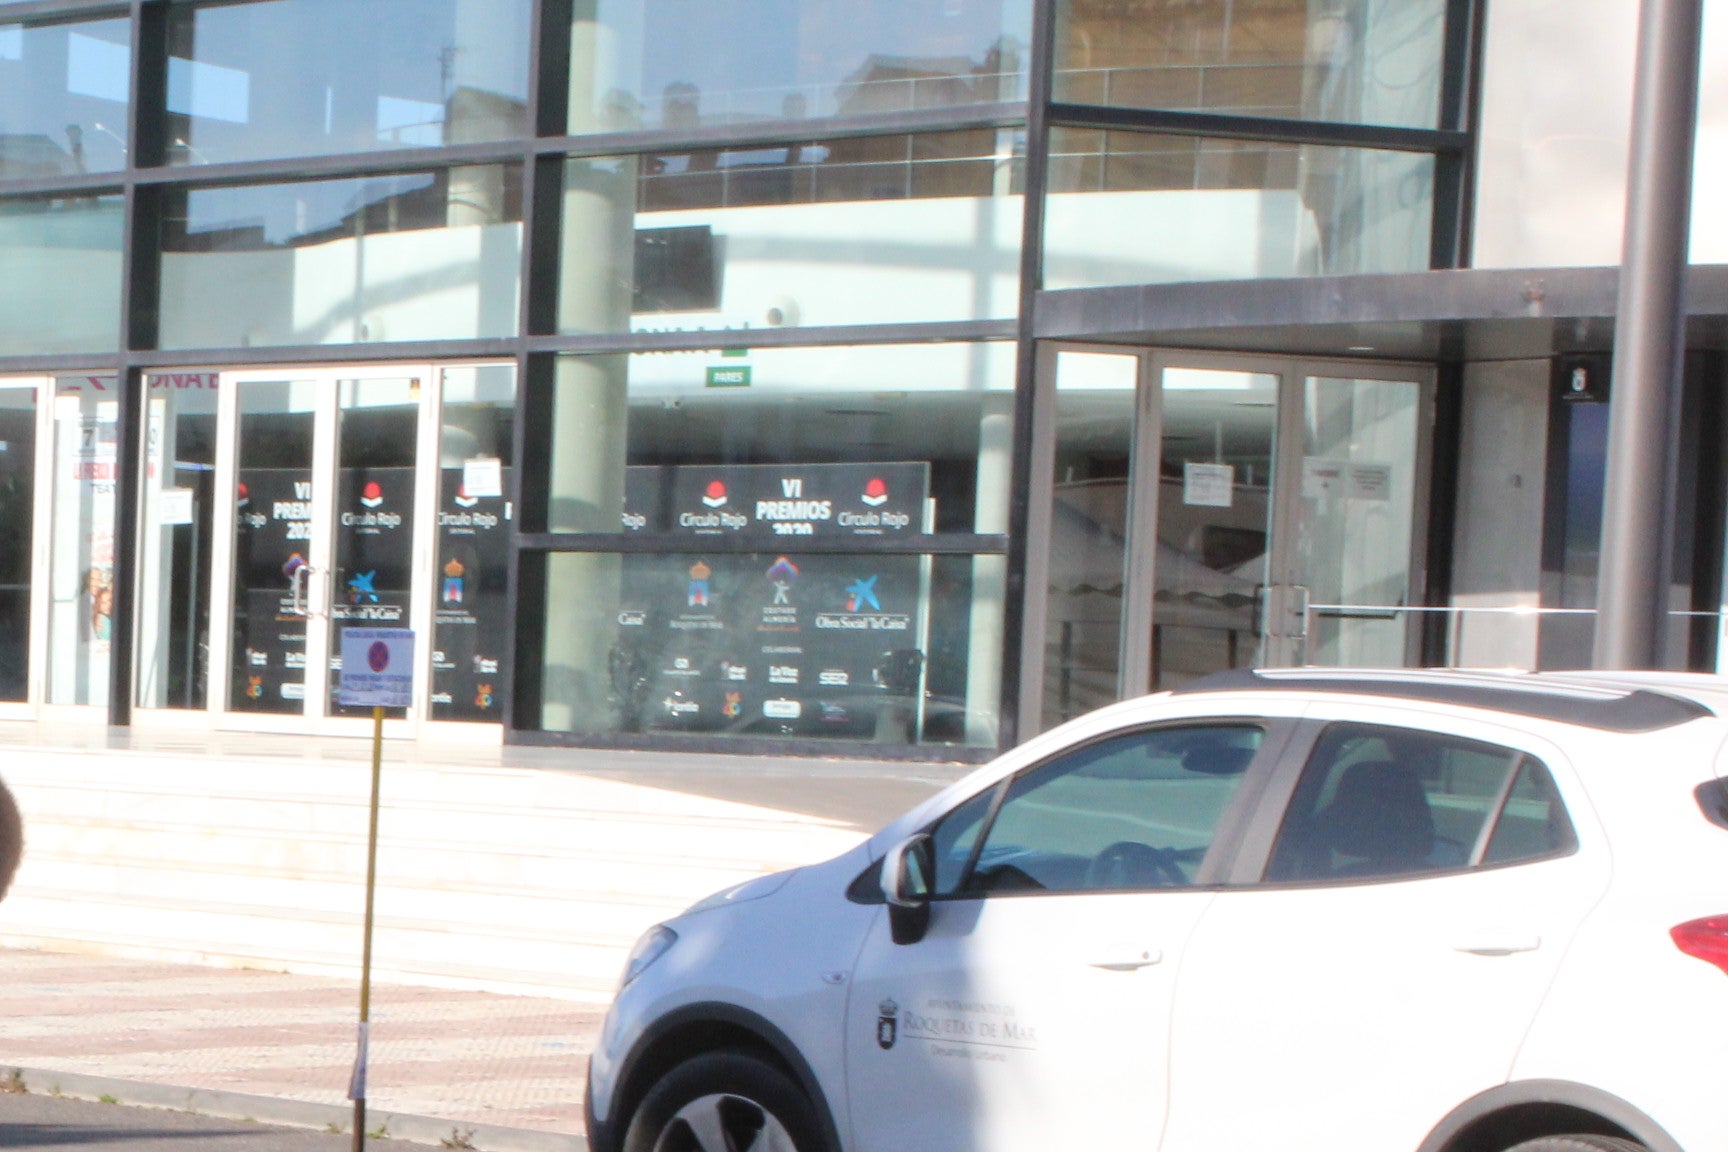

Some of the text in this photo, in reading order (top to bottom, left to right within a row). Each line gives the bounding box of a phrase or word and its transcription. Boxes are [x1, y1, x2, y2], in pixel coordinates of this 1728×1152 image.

[781, 478, 802, 498] VI
[377, 511, 402, 529] Rojo
[472, 511, 498, 529] Rojo
[756, 501, 832, 520] PREMIOS
[880, 510, 910, 529] Rojo
[720, 511, 748, 530] Rojo
[903, 1010, 973, 1035] ROQUETAS
[980, 1021, 998, 1039] DE
